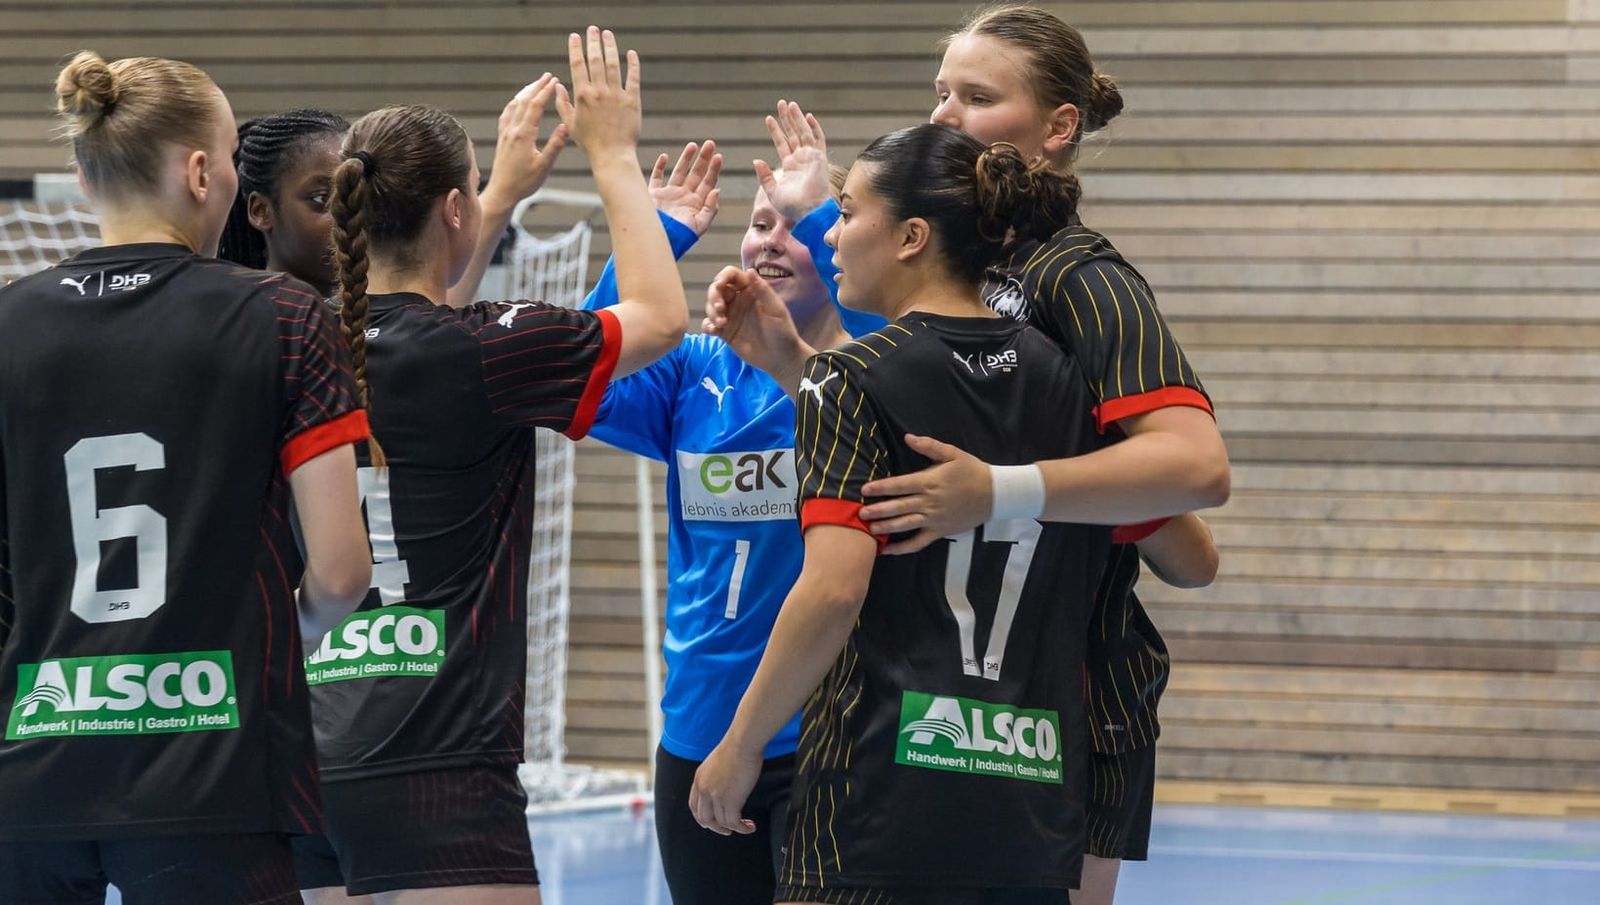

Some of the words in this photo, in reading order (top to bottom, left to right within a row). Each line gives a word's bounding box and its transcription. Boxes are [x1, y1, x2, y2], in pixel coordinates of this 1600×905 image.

[700, 451, 787, 494] eak
[64, 432, 168, 623] 6
[683, 499, 727, 517] lebnis
[724, 539, 751, 619] 1
[944, 517, 1044, 681] 17
[304, 614, 438, 668] LSCO
[16, 660, 228, 717] ALSCO
[322, 664, 358, 680] Industrie
[364, 661, 398, 673] Gastro
[406, 661, 438, 673] Hotel
[77, 716, 136, 731] Industrie
[145, 714, 188, 729] Gastro
[197, 713, 230, 726] Hotel
[901, 697, 1057, 762] ALSCO
[906, 749, 967, 769] Handwerk
[975, 757, 1014, 774] Industrie
